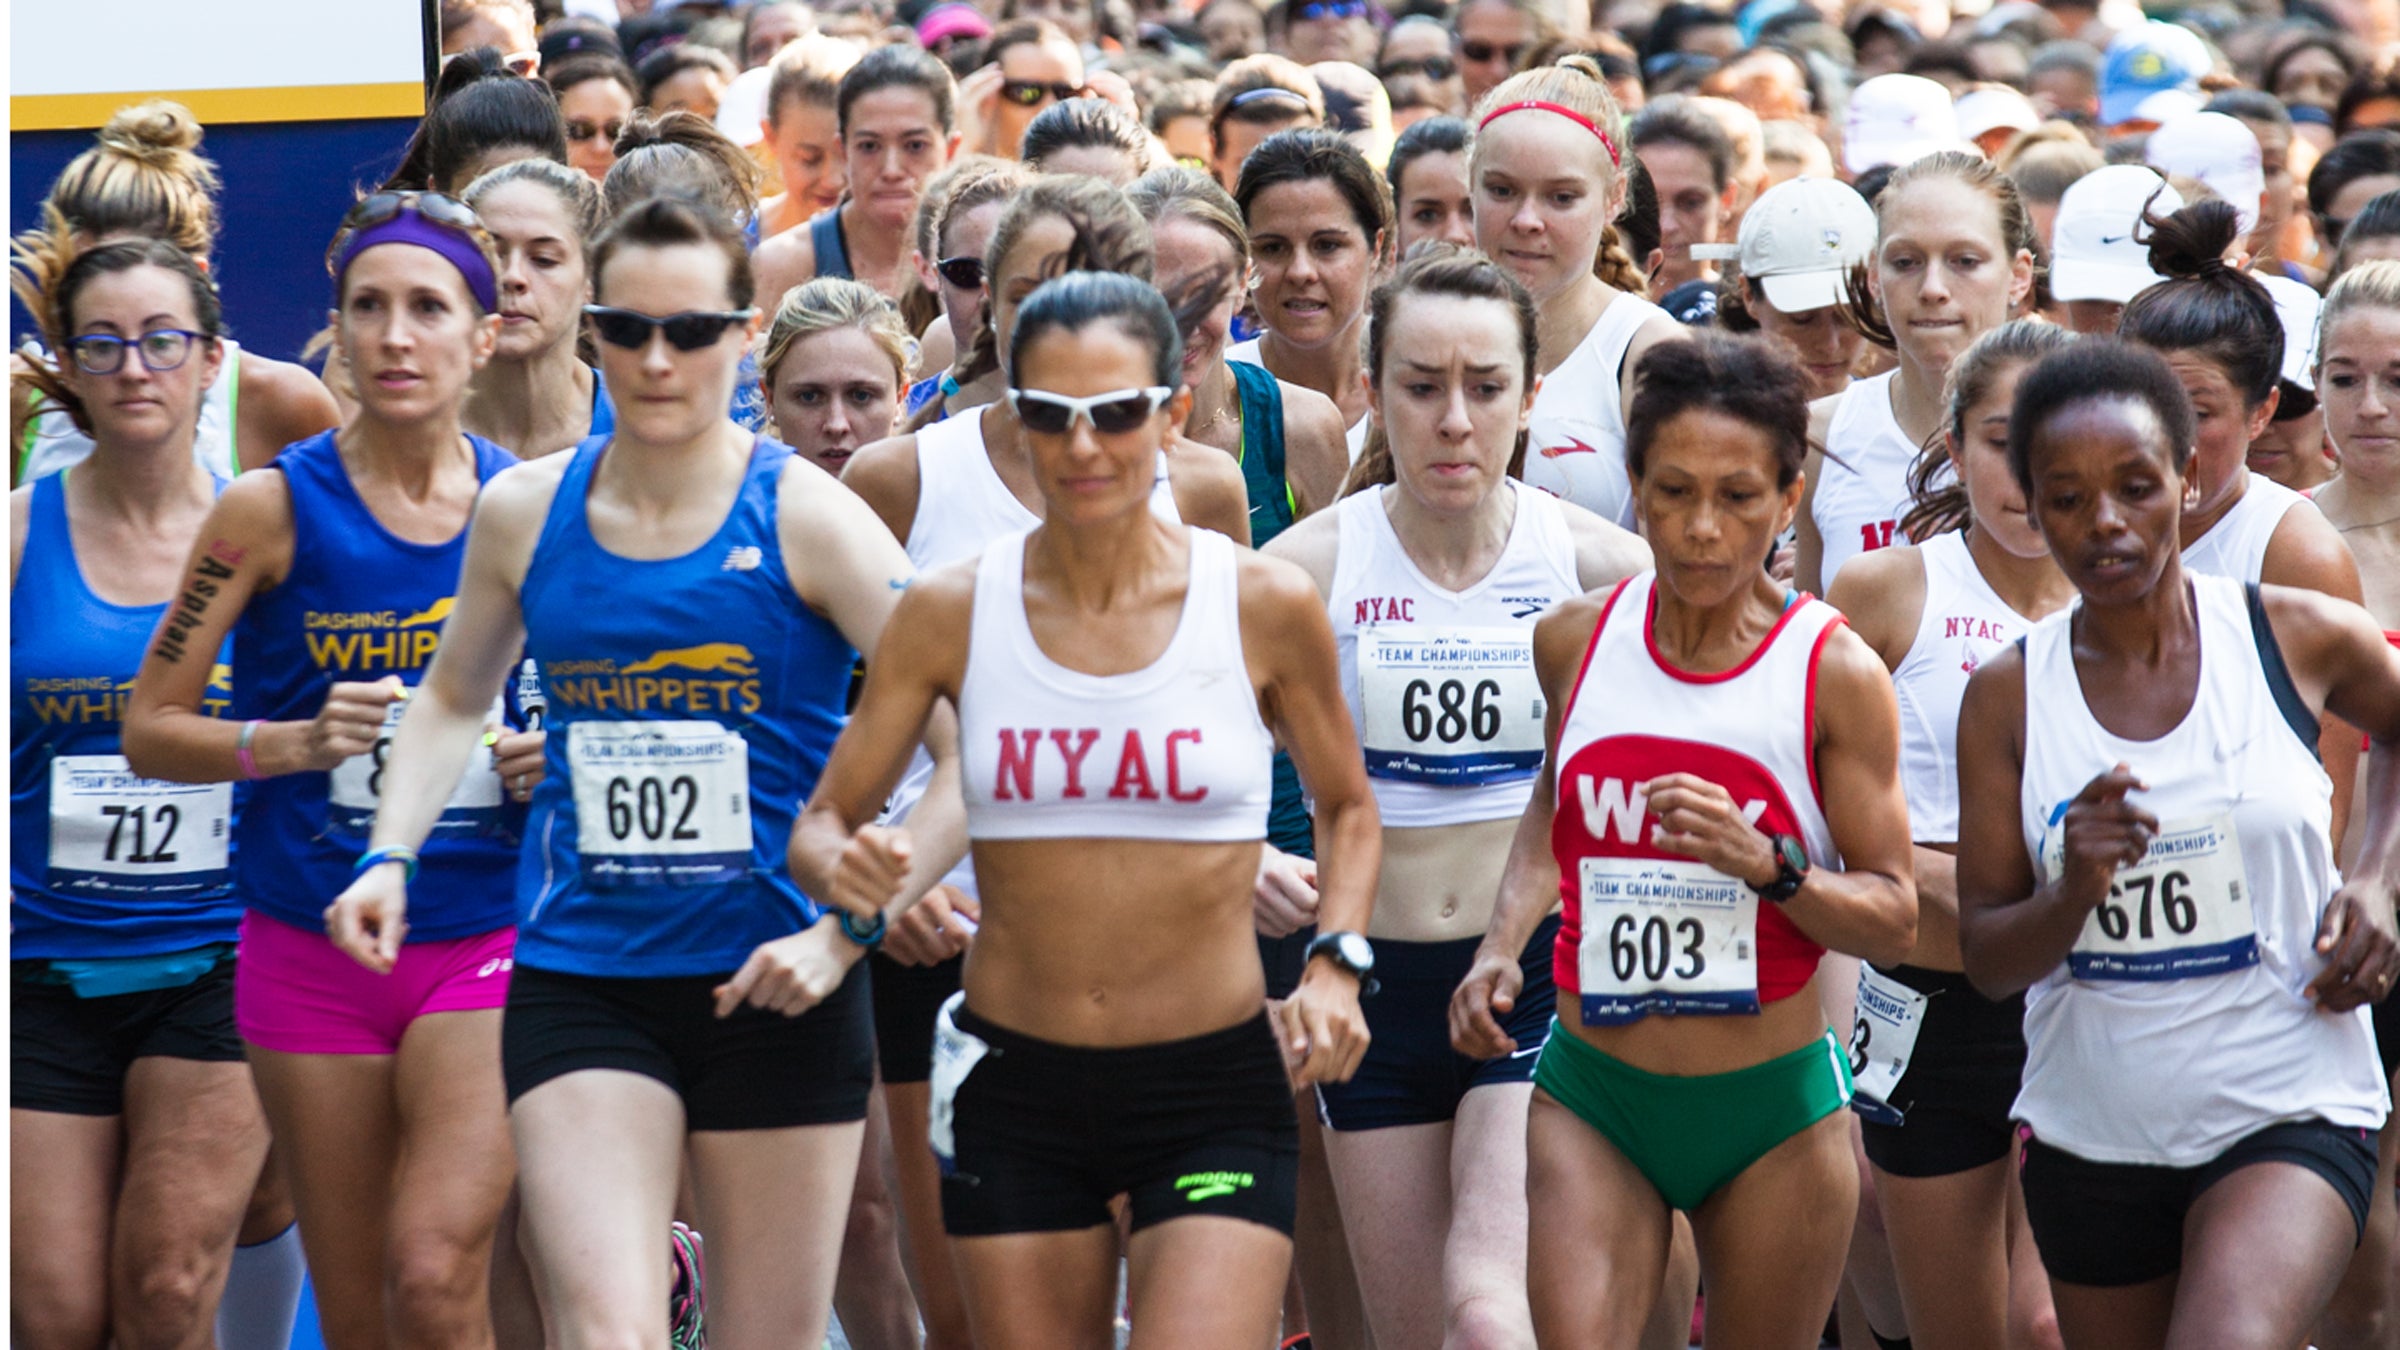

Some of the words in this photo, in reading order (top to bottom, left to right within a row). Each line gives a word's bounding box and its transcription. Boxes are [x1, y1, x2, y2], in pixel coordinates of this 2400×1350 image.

[155, 556, 234, 662] Asphalt
[304, 611, 396, 630] DASHING
[1355, 598, 1414, 624] NYAC
[1945, 617, 2003, 643] NYAC
[304, 631, 439, 671] WHIP
[1378, 648, 1413, 661] TEAM
[1421, 647, 1530, 661] CHAMPIONSHIPS
[546, 658, 616, 676] DASHING
[27, 677, 111, 692] DASHING
[552, 678, 761, 714] WHIPPETS
[1403, 679, 1500, 743] 686
[993, 728, 1208, 804] NYAC
[608, 775, 700, 841] 602
[102, 804, 182, 863] 712
[2150, 833, 2217, 856] IONSHIPS
[1595, 881, 1620, 894] TEAM
[1626, 881, 1737, 902] CHAMPIONSHIPS
[2097, 869, 2198, 941] 676
[1610, 913, 1706, 982] 603
[1174, 1170, 1254, 1190] BROOKS
